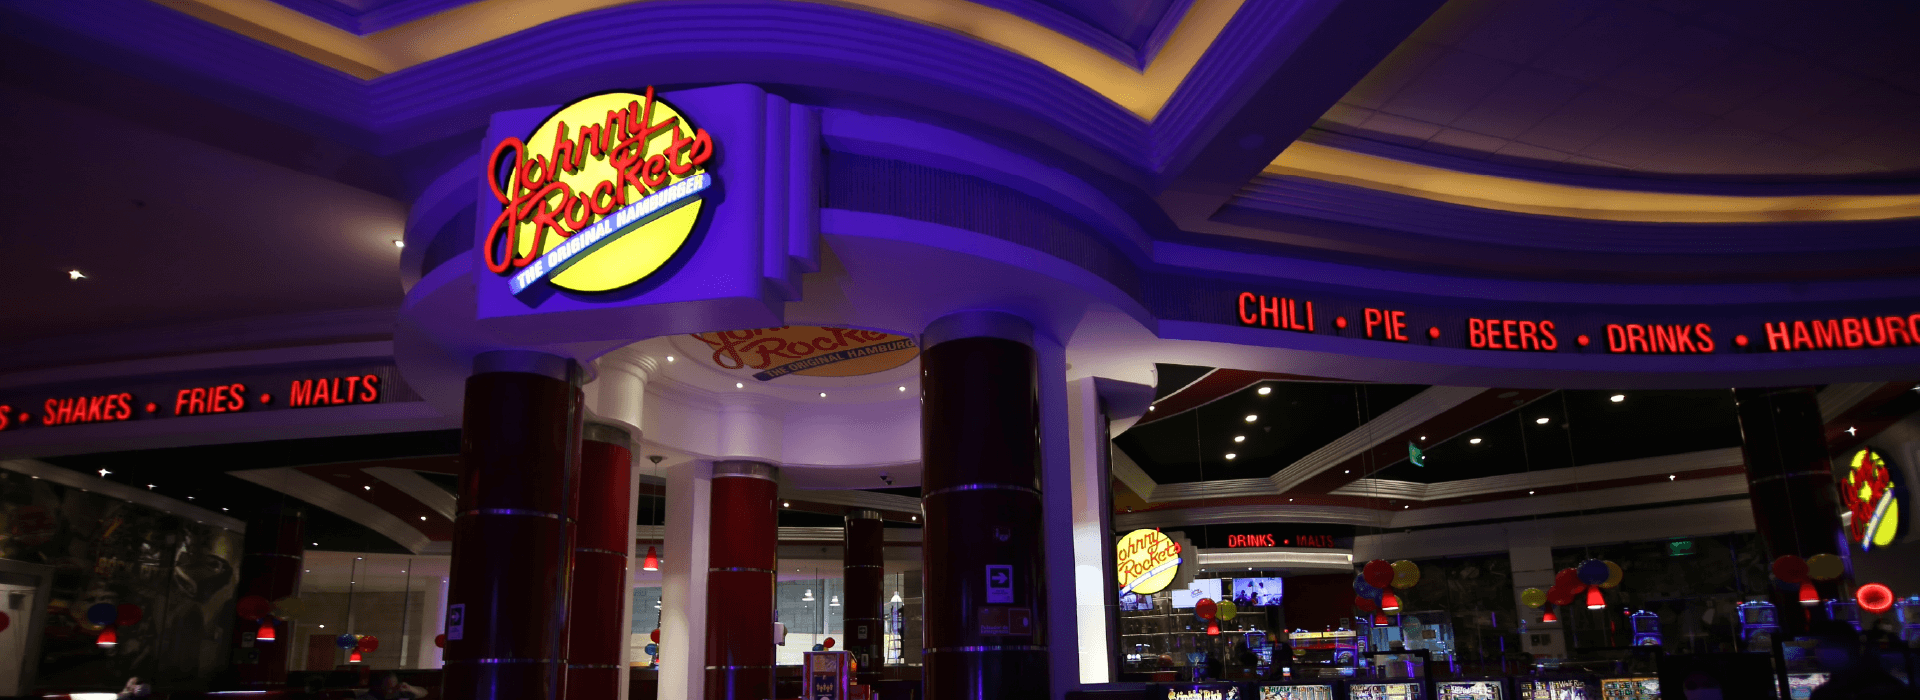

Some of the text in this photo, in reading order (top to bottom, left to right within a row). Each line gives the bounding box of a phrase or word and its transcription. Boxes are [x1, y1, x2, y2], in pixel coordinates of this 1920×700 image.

[484, 85, 679, 273] Johnny
[512, 125, 714, 267] Rockets
[516, 174, 704, 289] THE ORIGINAL HAMBURGER
[1238, 291, 1315, 332] CHILI
[1364, 307, 1409, 341] PIE
[1469, 317, 1558, 350] BEERS
[1606, 323, 1715, 353] DRINKS
[765, 338, 915, 378] THE ORIGINAL HAMBURG
[43, 392, 132, 427] SHAKES
[174, 383, 246, 416] FRIES
[290, 374, 379, 407] MALTS
[1118, 527, 1168, 567] ohnny
[1119, 541, 1182, 587] Rockets
[1228, 534, 1335, 548] DRINKS MALTS
